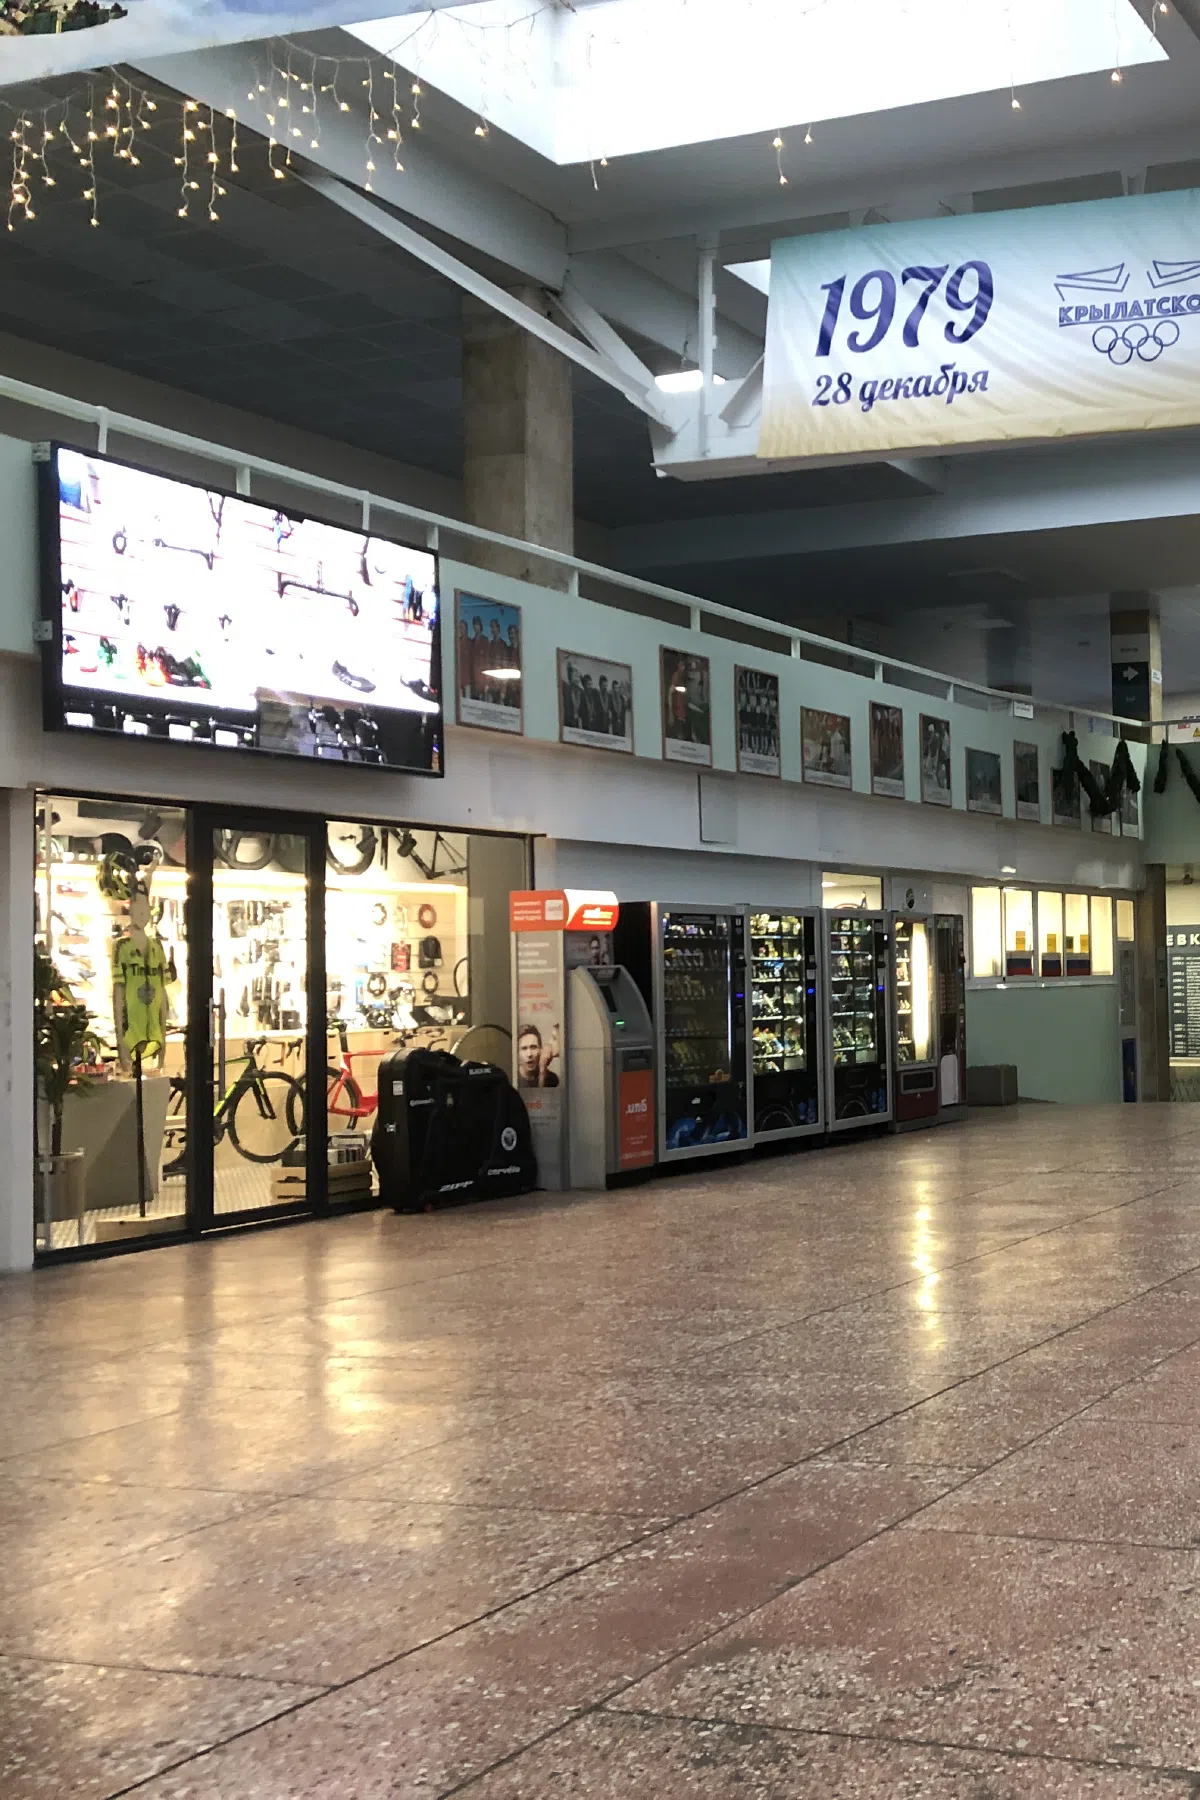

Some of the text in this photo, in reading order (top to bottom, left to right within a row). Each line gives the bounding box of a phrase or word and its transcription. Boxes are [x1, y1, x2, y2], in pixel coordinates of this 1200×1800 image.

[815, 260, 994, 358] 1979
[812, 362, 989, 413] 28 декабря
[1177, 933, 1187, 946] В
